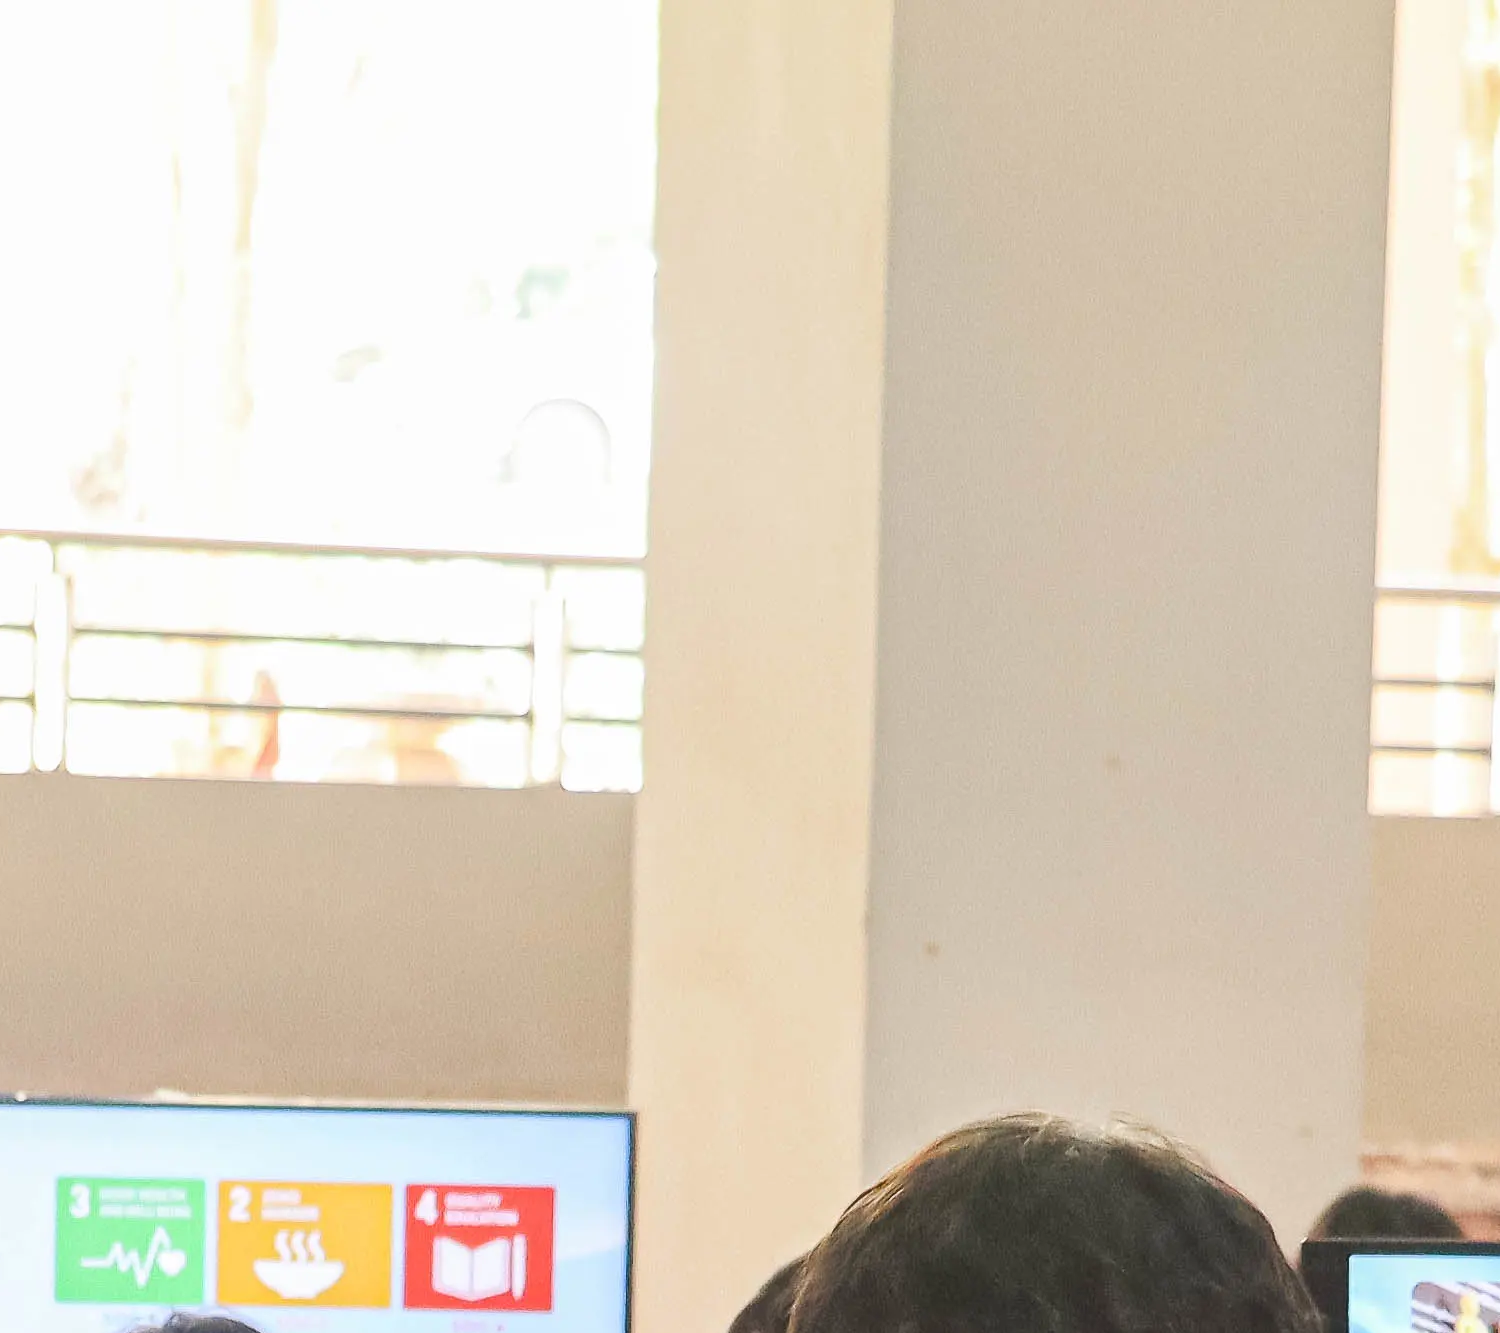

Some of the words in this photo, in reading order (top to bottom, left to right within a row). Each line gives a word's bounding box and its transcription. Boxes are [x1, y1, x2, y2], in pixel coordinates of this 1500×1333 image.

[69, 1184, 90, 1218] 3
[227, 1185, 251, 1222] 2
[414, 1188, 439, 1227] 4
